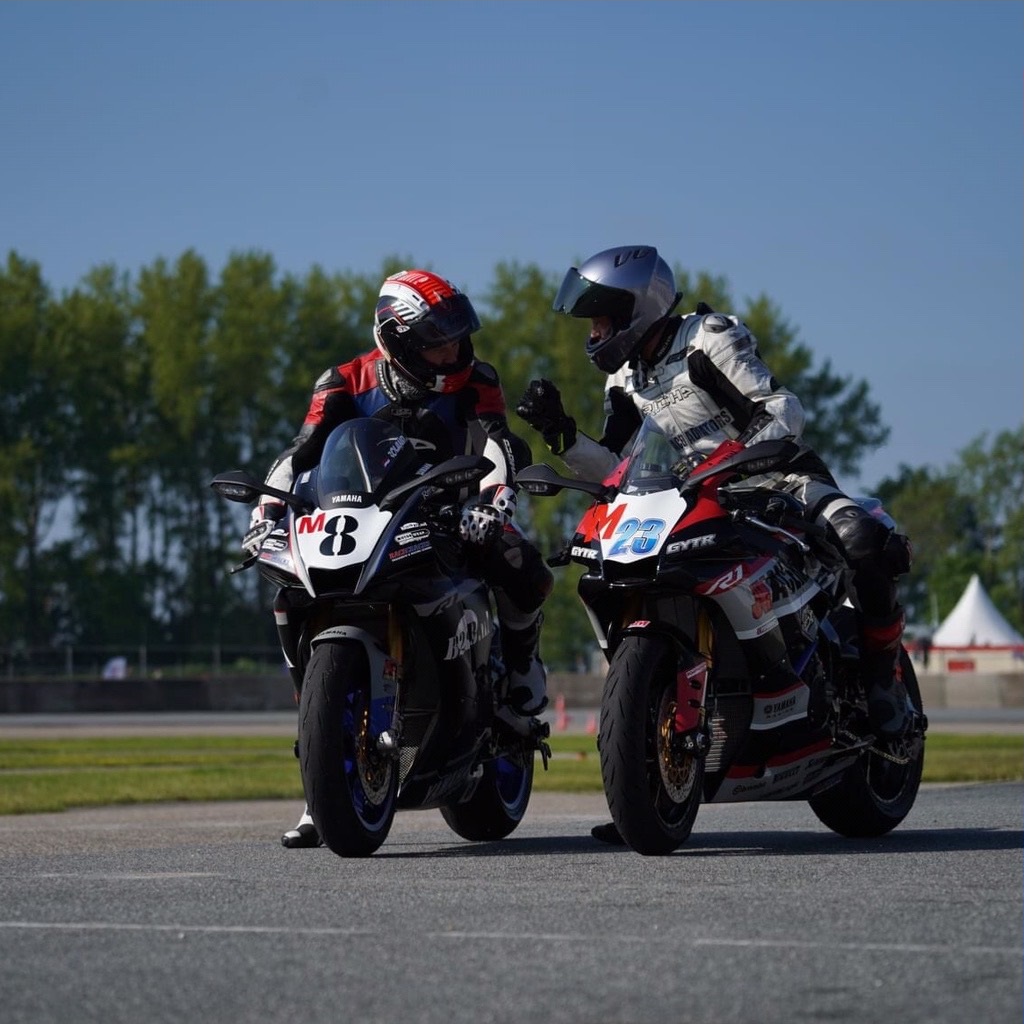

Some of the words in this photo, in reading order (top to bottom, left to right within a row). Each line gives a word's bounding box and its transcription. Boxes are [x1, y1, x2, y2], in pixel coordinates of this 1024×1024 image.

[331, 495, 363, 505] YAMAHA
[298, 513, 325, 534] M
[319, 515, 359, 556] 8
[608, 518, 666, 556] 23
[665, 533, 718, 555] GYTR
[571, 546, 599, 560] GYTR
